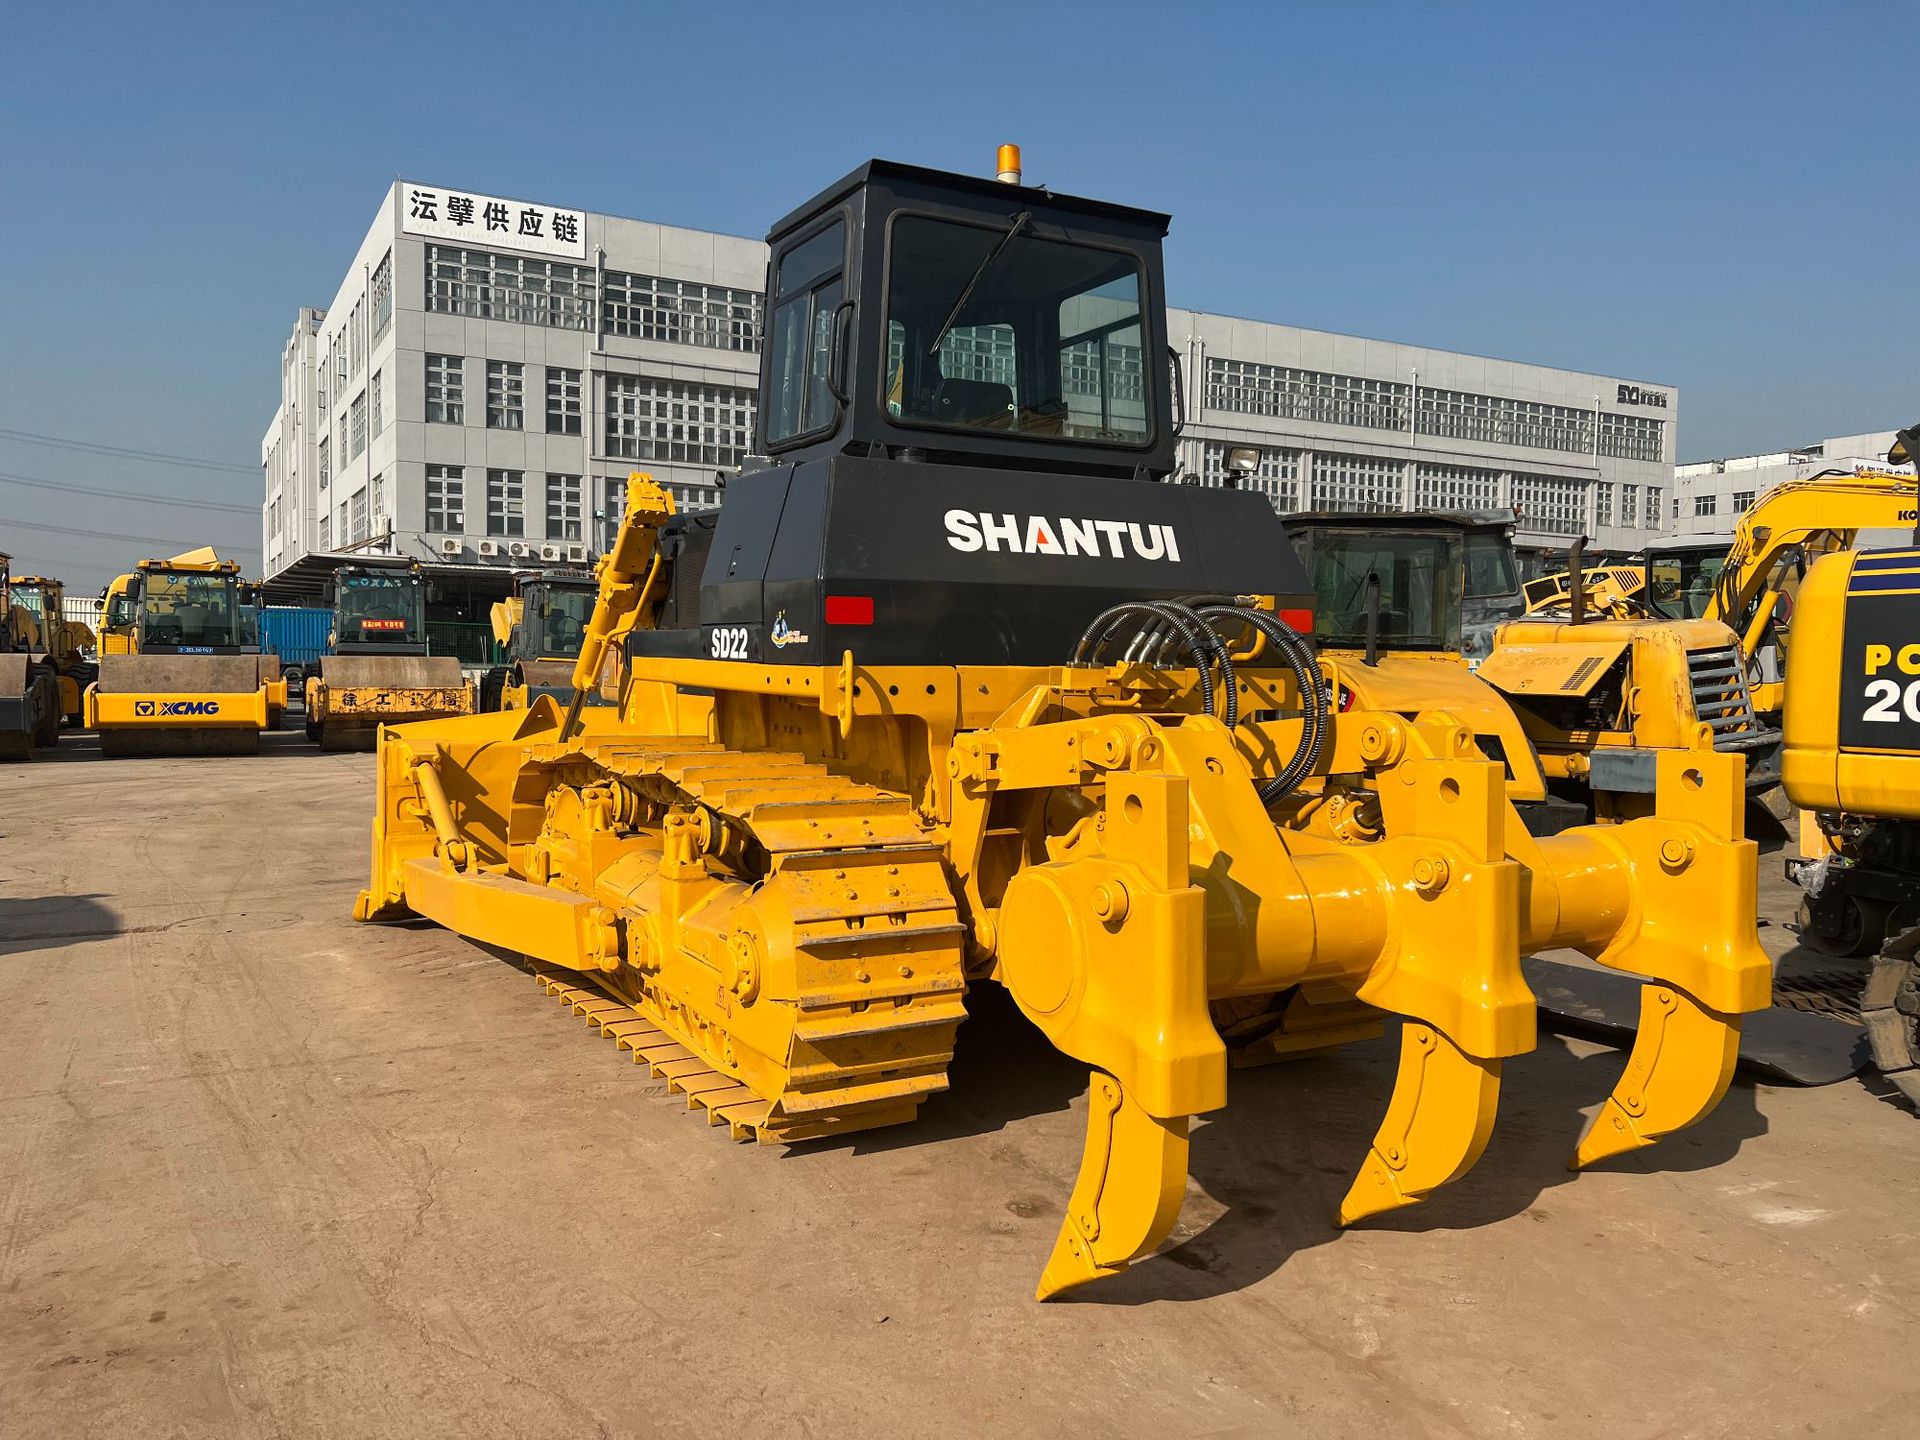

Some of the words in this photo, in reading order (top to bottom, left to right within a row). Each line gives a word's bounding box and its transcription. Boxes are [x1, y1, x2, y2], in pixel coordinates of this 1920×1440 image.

[944, 509, 1181, 562] SHANTUI
[711, 627, 748, 659] SD22
[1864, 643, 1920, 675] PC
[158, 701, 220, 716] XCMG
